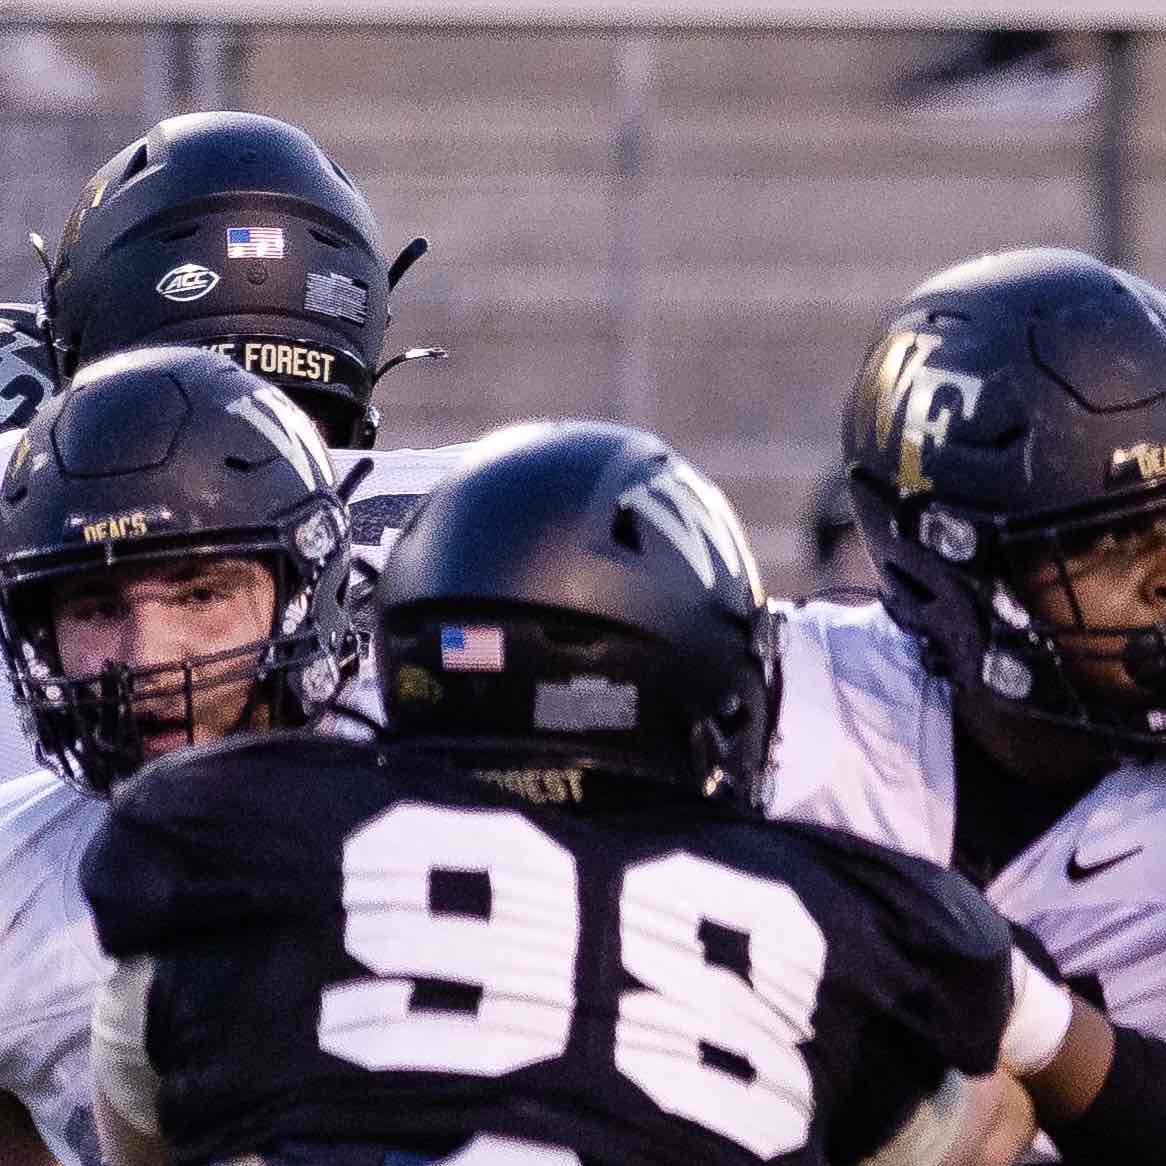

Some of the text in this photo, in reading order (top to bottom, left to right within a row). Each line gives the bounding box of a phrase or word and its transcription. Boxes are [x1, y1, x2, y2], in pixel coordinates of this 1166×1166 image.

[164, 271, 211, 291] ACC
[245, 343, 335, 382] FOREST
[316, 800, 828, 1160] 98
